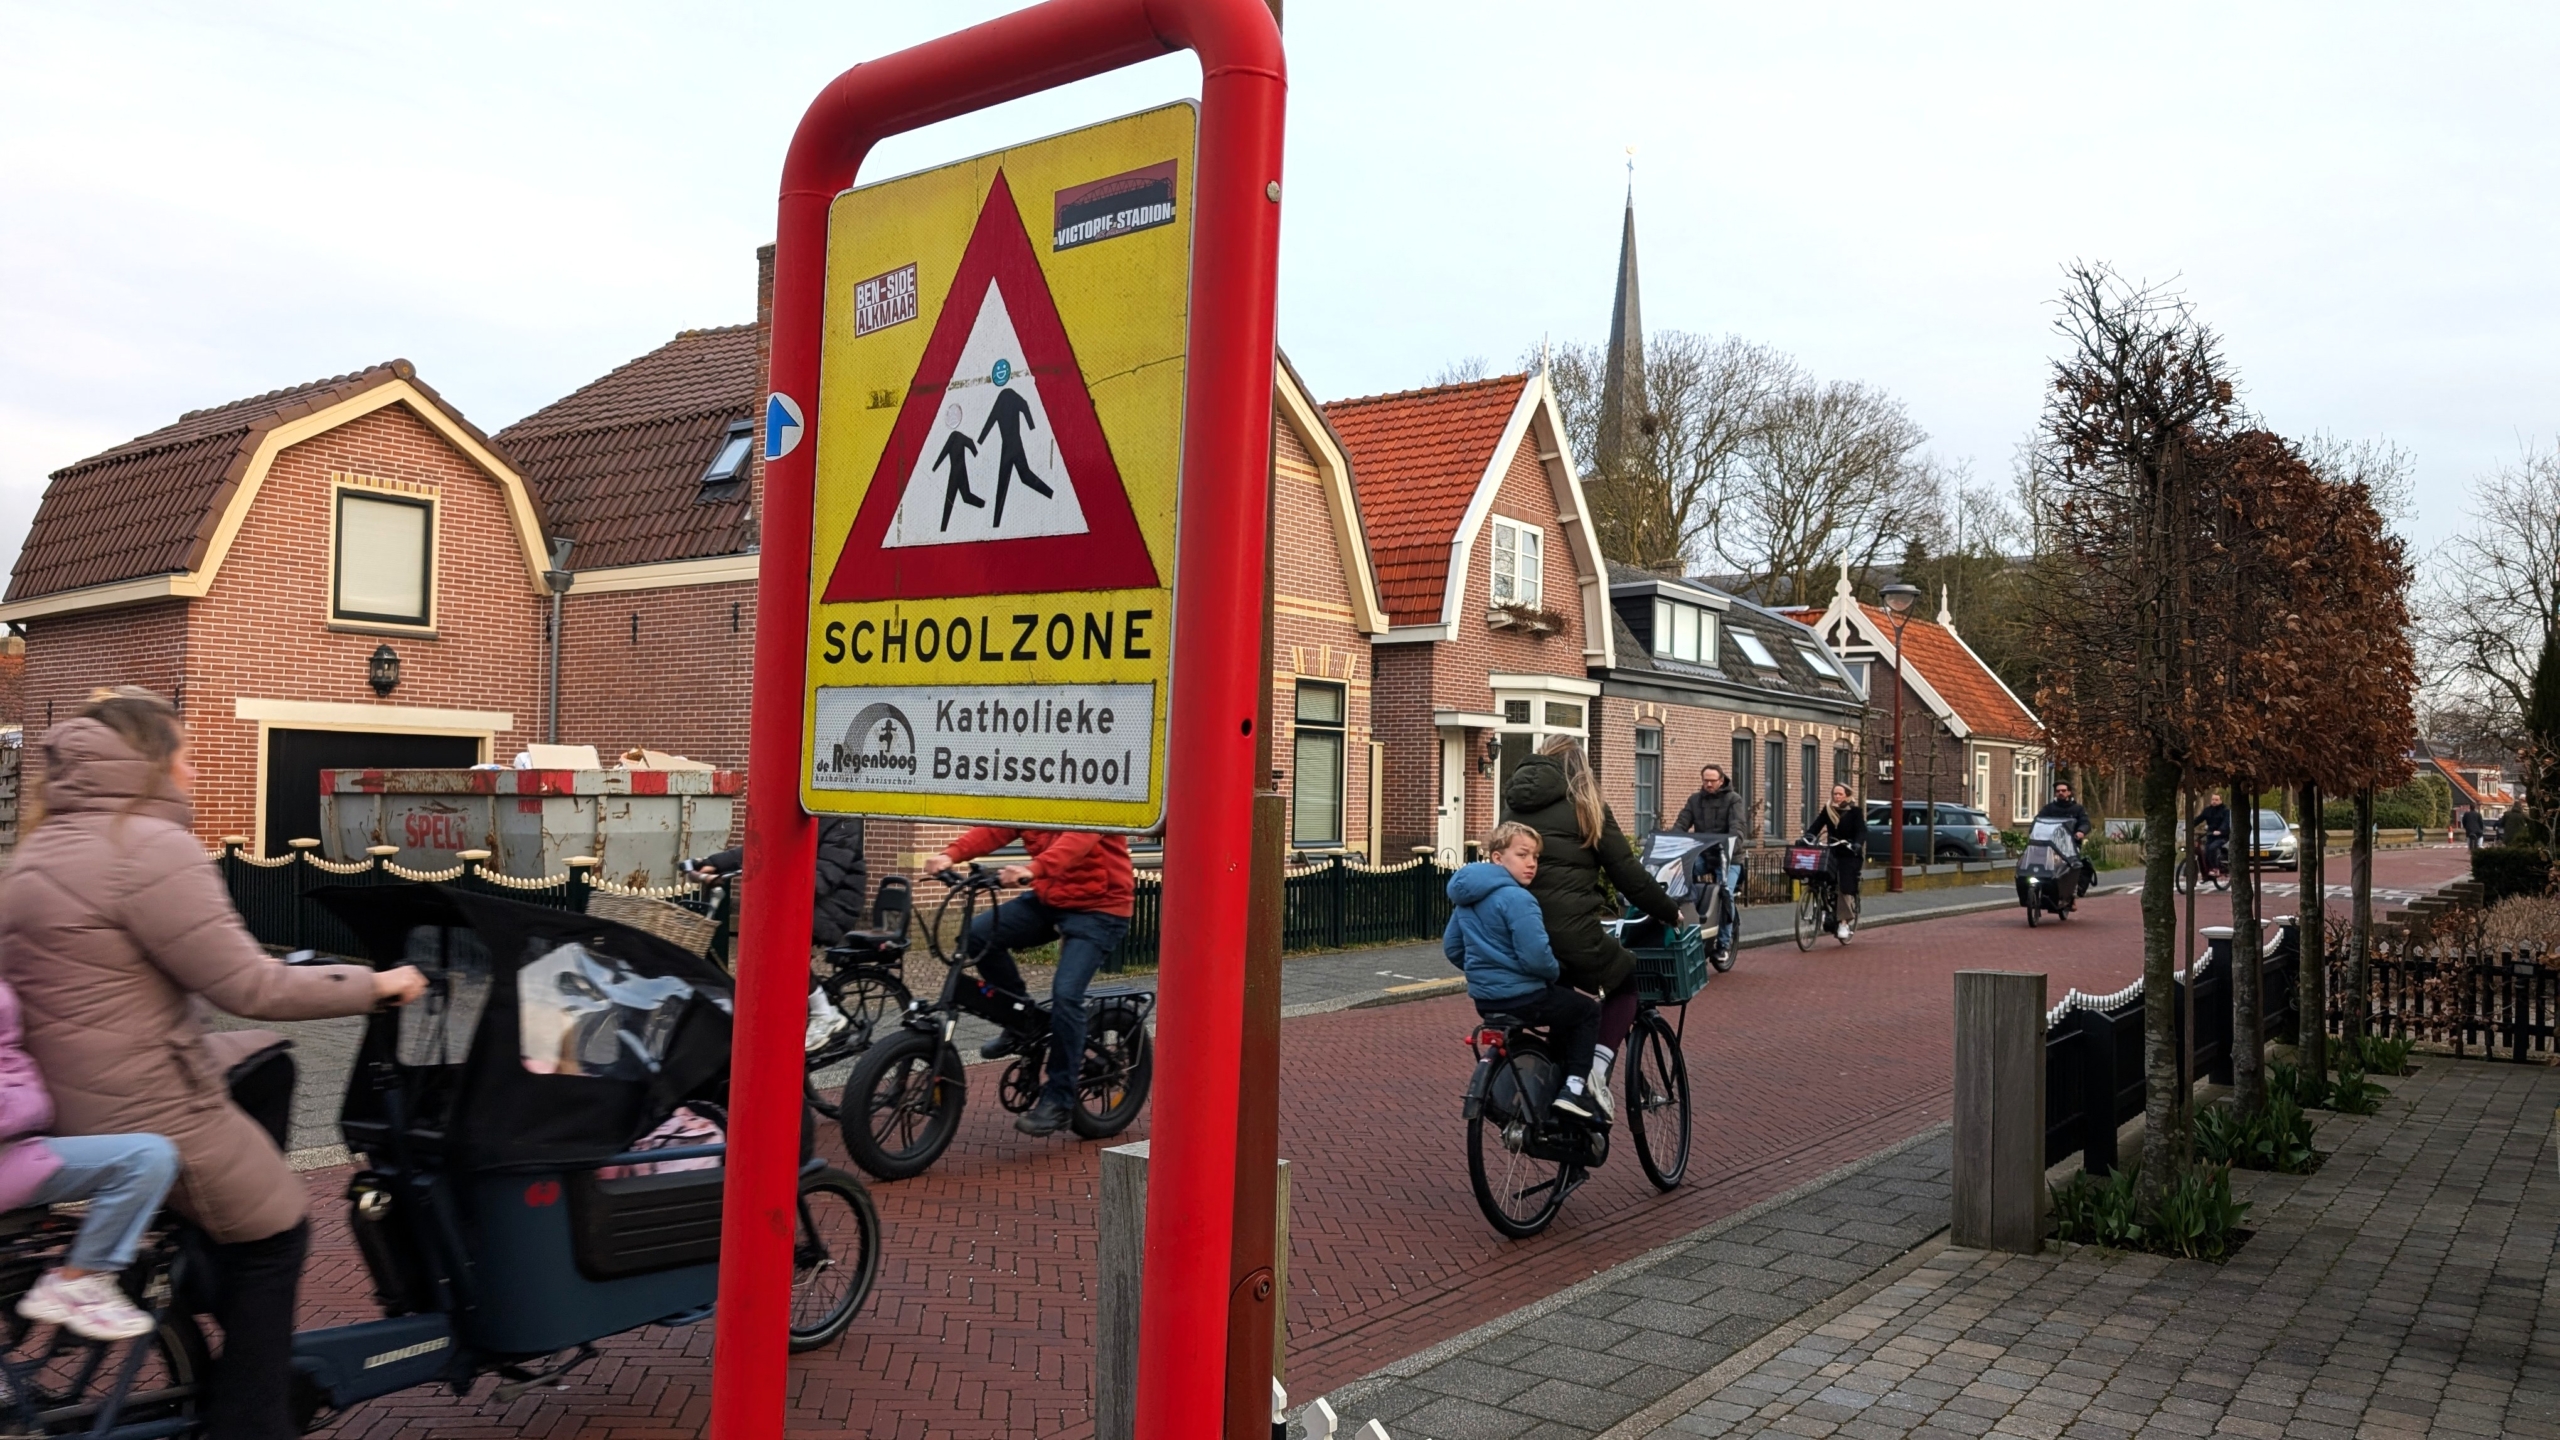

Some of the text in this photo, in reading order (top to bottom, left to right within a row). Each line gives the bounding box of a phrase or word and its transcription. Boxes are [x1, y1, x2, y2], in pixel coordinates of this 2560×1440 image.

[857, 267, 915, 310] BEN-SIDE
[858, 292, 915, 334] ALKMAAR
[822, 609, 1154, 665] SCHOOLZONE
[935, 698, 1115, 735] Katholieke
[816, 743, 918, 776] de Regenboog
[932, 746, 1131, 787] Basisschool
